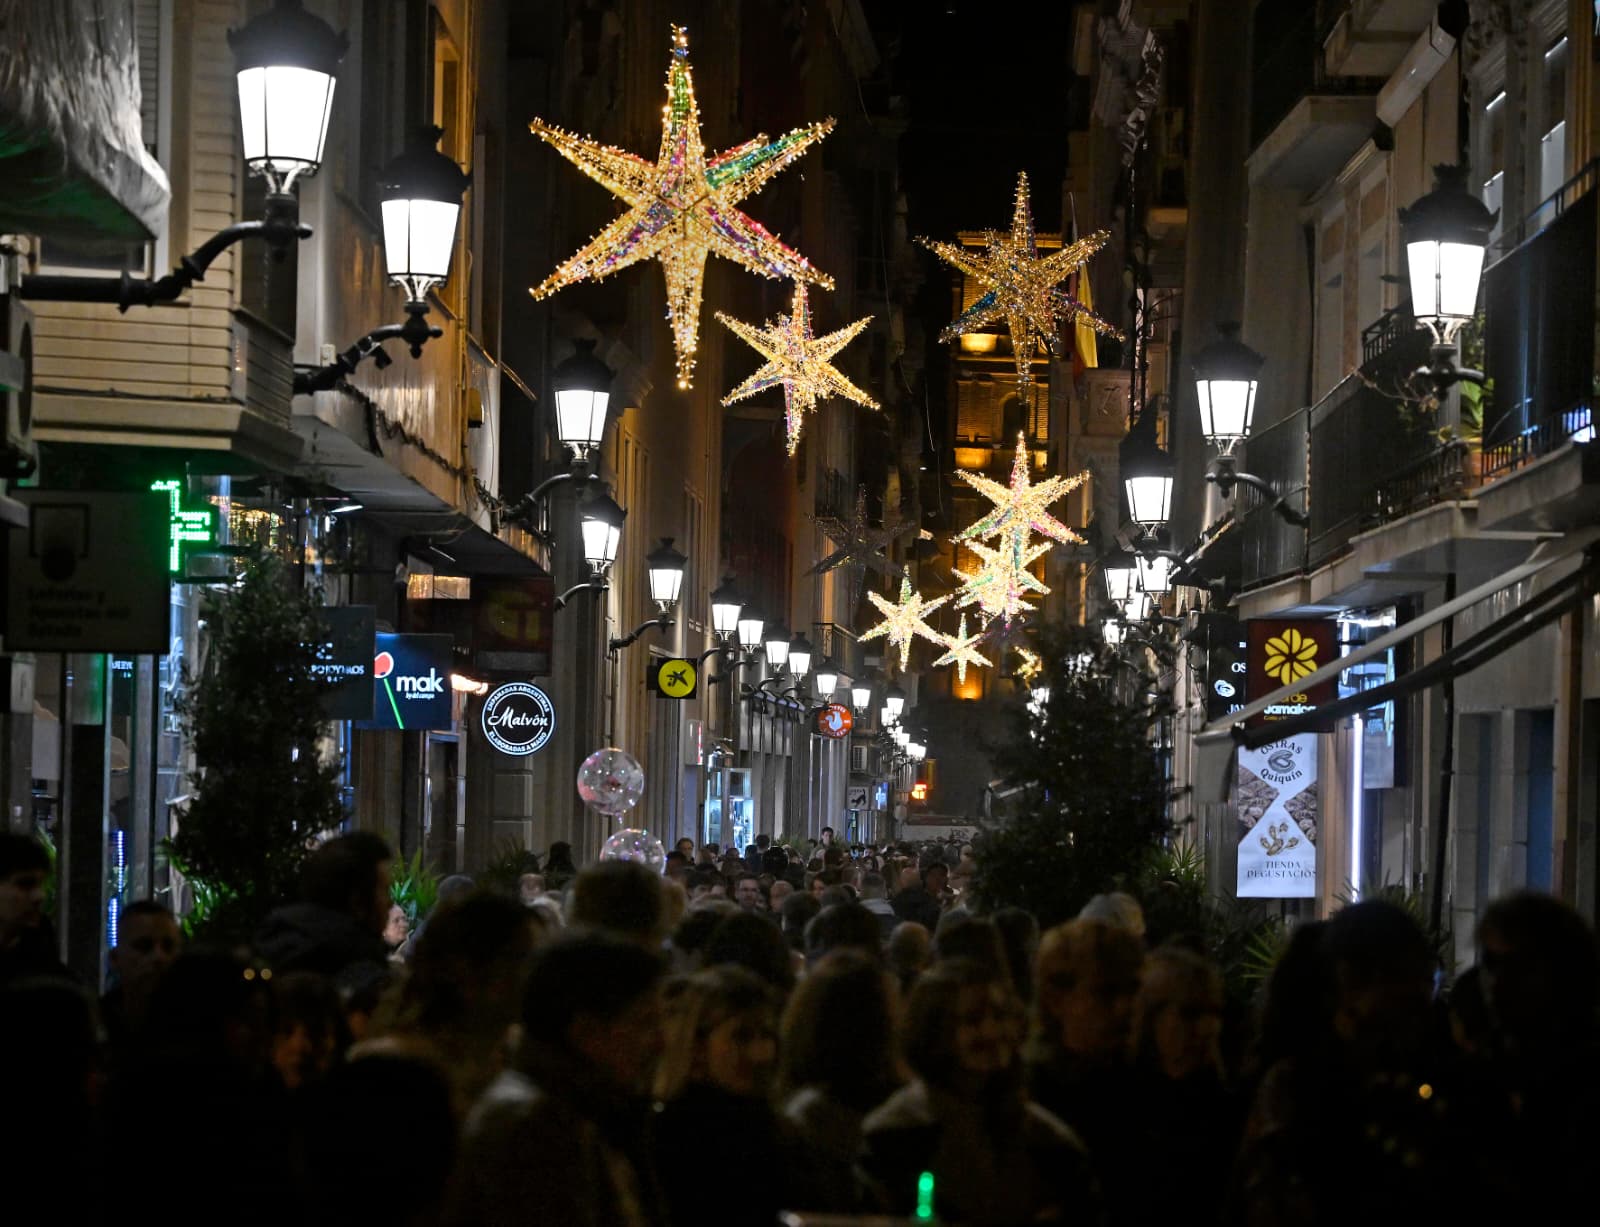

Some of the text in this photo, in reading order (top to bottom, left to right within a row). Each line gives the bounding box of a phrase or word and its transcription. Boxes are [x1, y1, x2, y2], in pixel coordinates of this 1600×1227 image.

[396, 667, 444, 692] mak
[487, 706, 548, 729] Malvón
[488, 731, 526, 752] ELABORADAS
[530, 732, 547, 748] MANO
[1265, 861, 1301, 869] TIENDA
